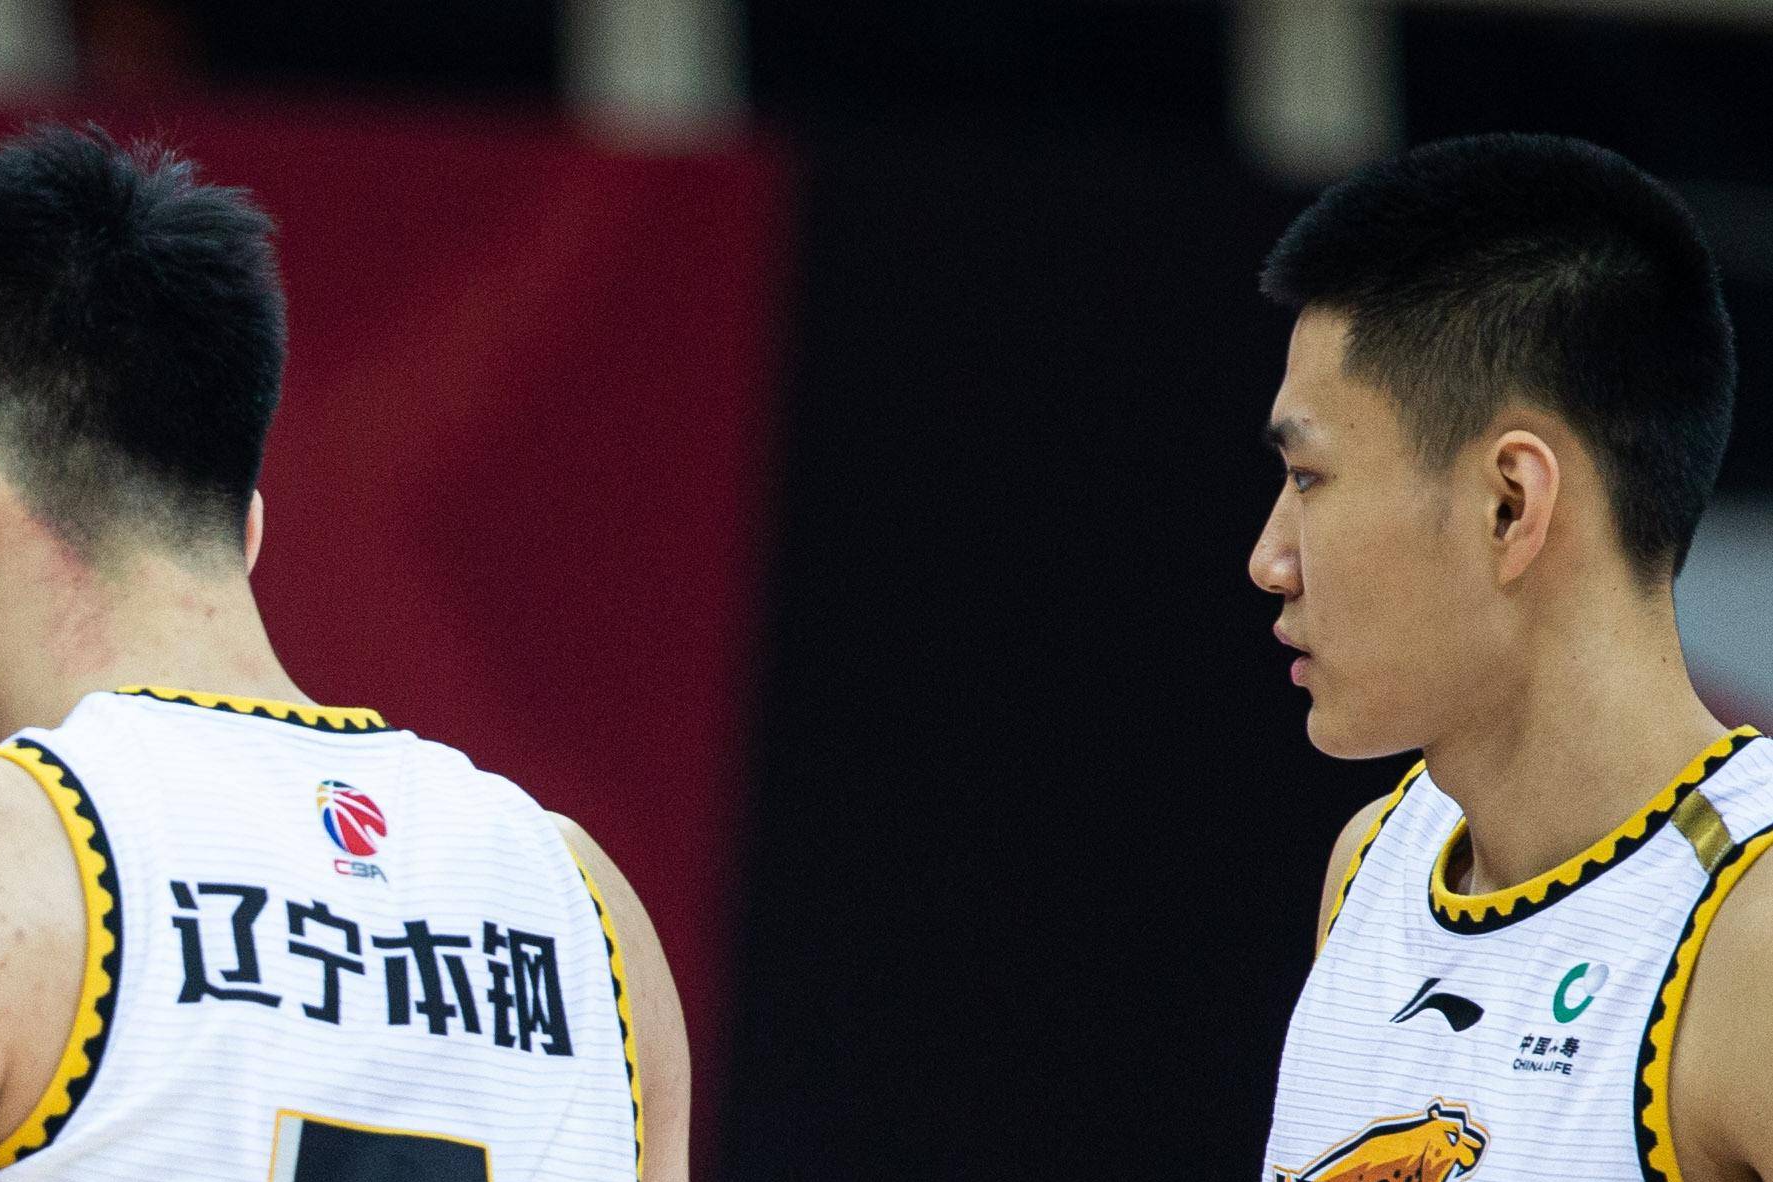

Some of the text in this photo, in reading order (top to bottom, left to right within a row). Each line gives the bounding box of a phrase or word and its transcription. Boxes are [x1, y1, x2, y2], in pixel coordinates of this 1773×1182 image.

[170, 880, 574, 1056] 辽宁本钢
[1513, 1059, 1573, 1075] CHINA LIFE
